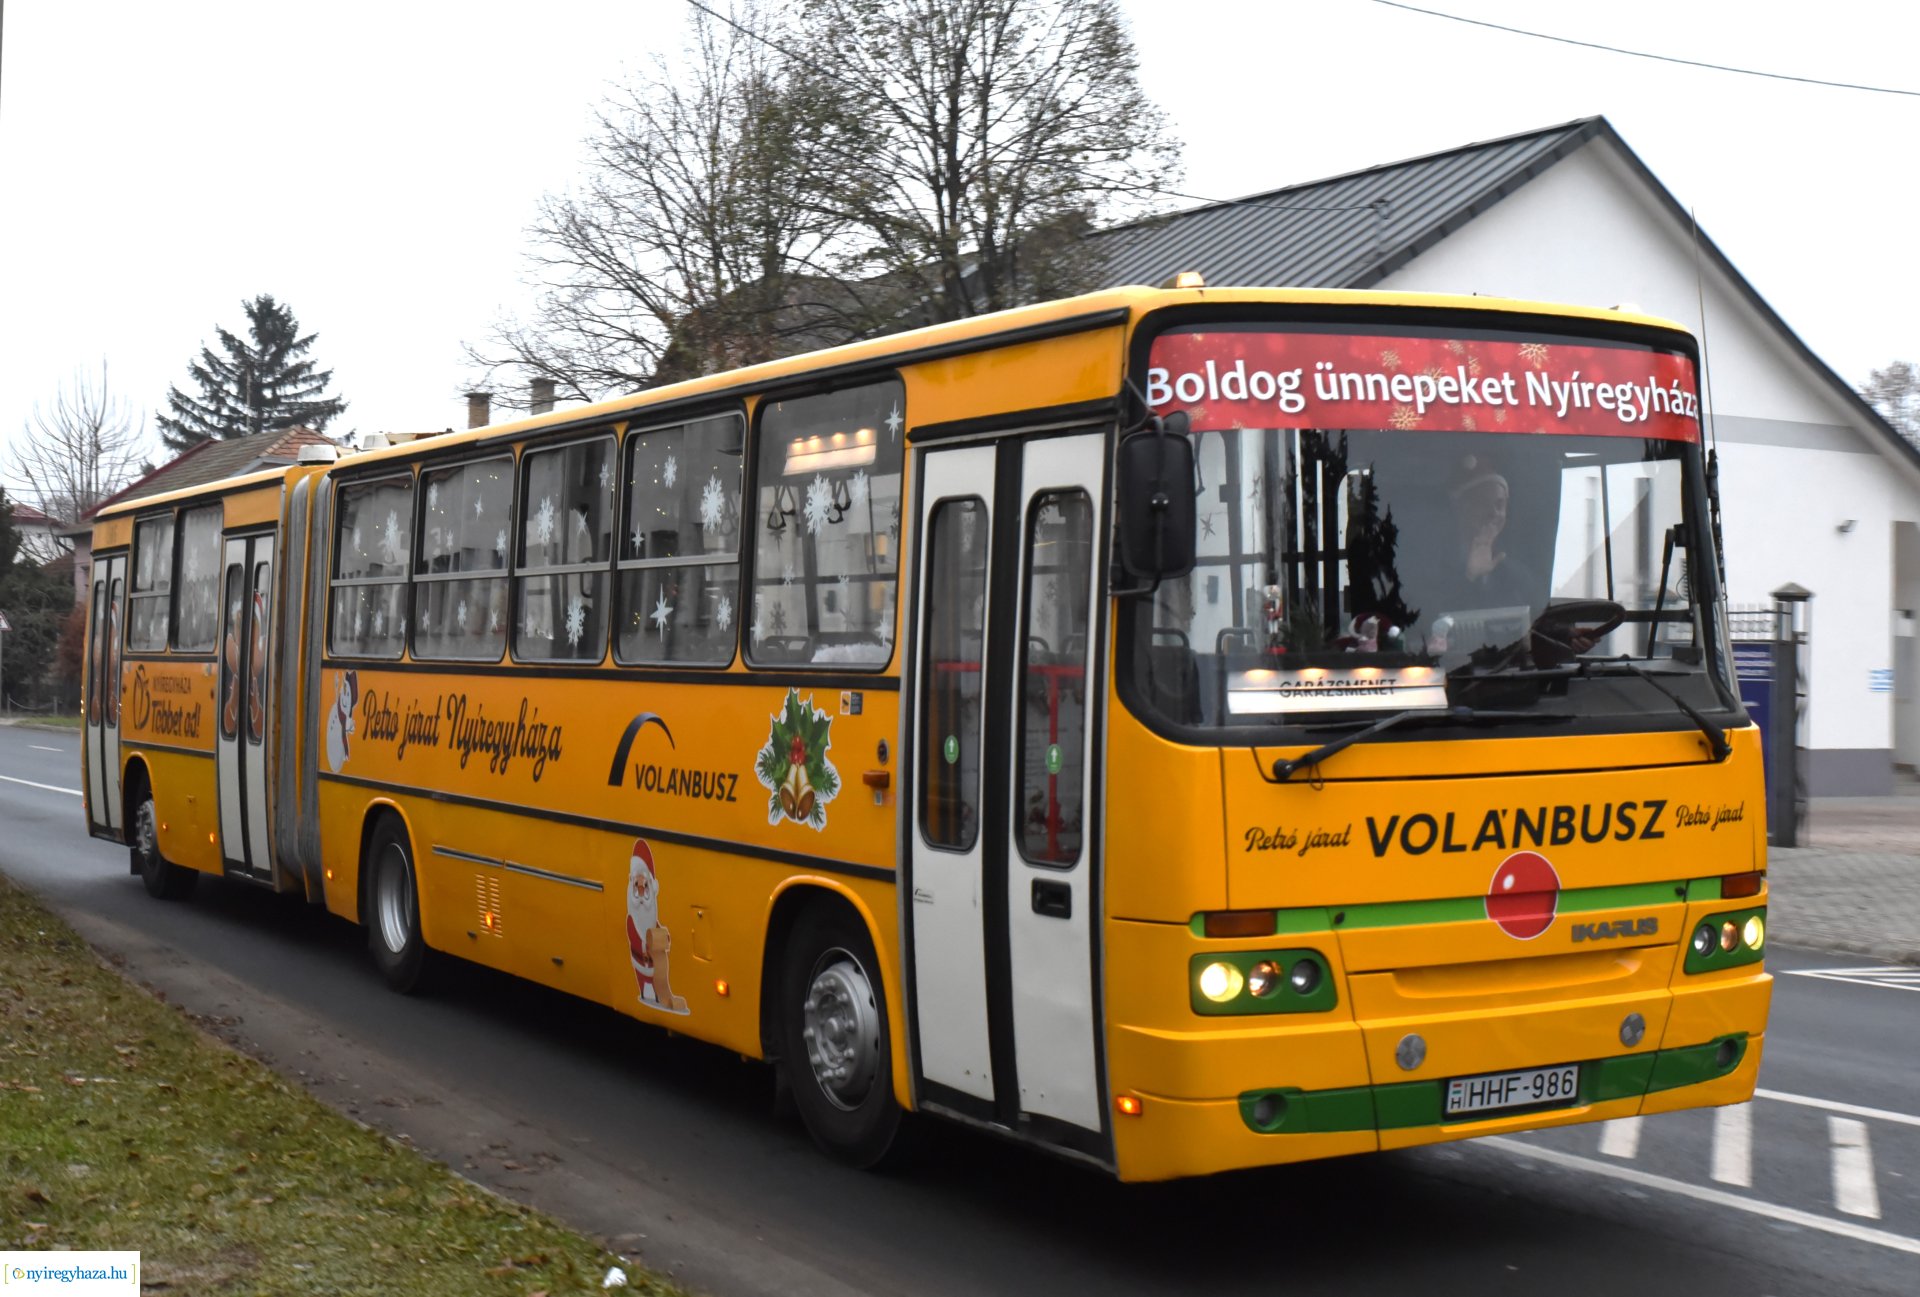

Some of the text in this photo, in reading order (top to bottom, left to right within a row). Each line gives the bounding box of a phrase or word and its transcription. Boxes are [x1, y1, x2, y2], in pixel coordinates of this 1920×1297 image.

[1146, 360, 1306, 414] Boldog
[1314, 361, 1519, 414] ünnepeket
[1279, 677, 1397, 698] GARÁZSMENET
[362, 689, 563, 782] Retró járat Nyíregyháza
[635, 763, 739, 802] VOLÁNBUSZ
[1365, 800, 1667, 858] VOLÁNBUSZ
[1675, 800, 1745, 832] Retró járat
[1244, 823, 1353, 857] Retró járat
[1571, 917, 1659, 943] IKARUS
[1450, 1070, 1575, 1109] H HHF-986
